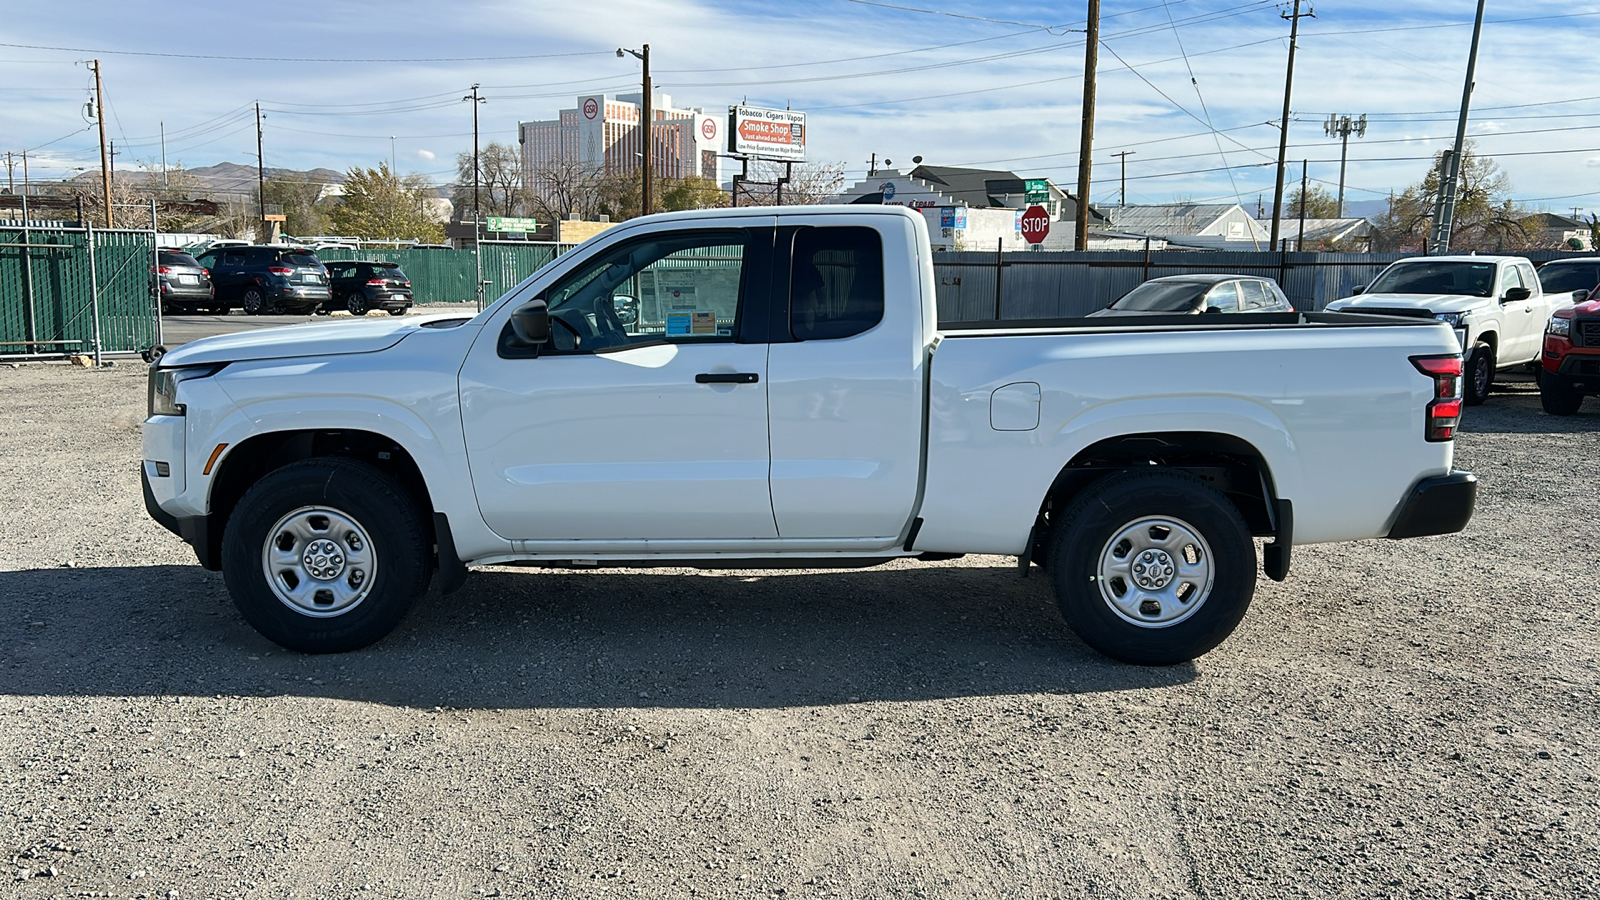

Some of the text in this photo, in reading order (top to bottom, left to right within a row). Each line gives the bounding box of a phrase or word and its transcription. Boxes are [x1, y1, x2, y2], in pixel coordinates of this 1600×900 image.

[738, 109, 803, 122] Tobacco Cigars Vapor
[744, 121, 769, 132] Smoke
[770, 123, 788, 136] Shop
[756, 144, 775, 152] Guarantee
[1023, 217, 1048, 233] STOP
